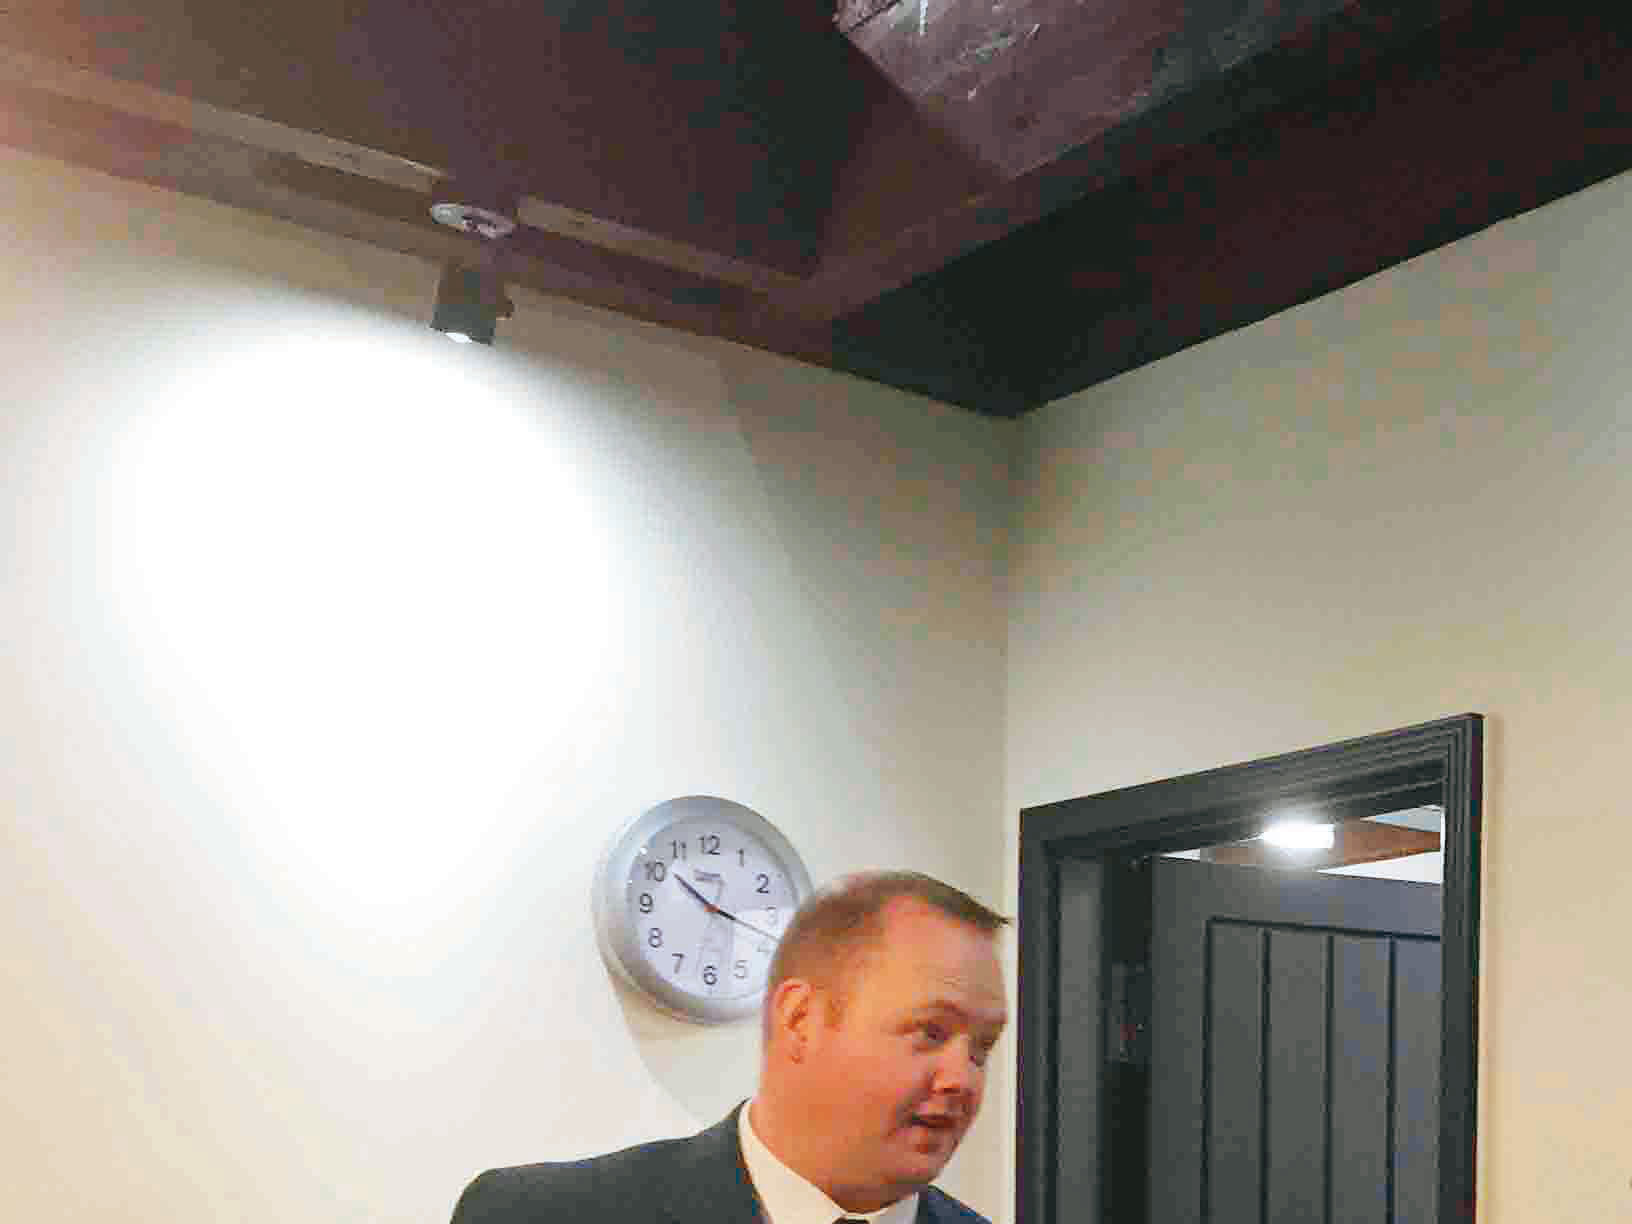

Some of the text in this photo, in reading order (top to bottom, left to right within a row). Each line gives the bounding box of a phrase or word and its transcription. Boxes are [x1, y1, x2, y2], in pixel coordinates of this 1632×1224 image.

[670, 840, 687, 860] 11
[698, 835, 721, 855] 12
[738, 849, 745, 867] 1
[645, 862, 667, 882] 10
[755, 874, 769, 893] 2
[640, 893, 653, 913] 9
[648, 928, 663, 948] 8
[672, 953, 685, 974] 7
[703, 965, 717, 985] 6
